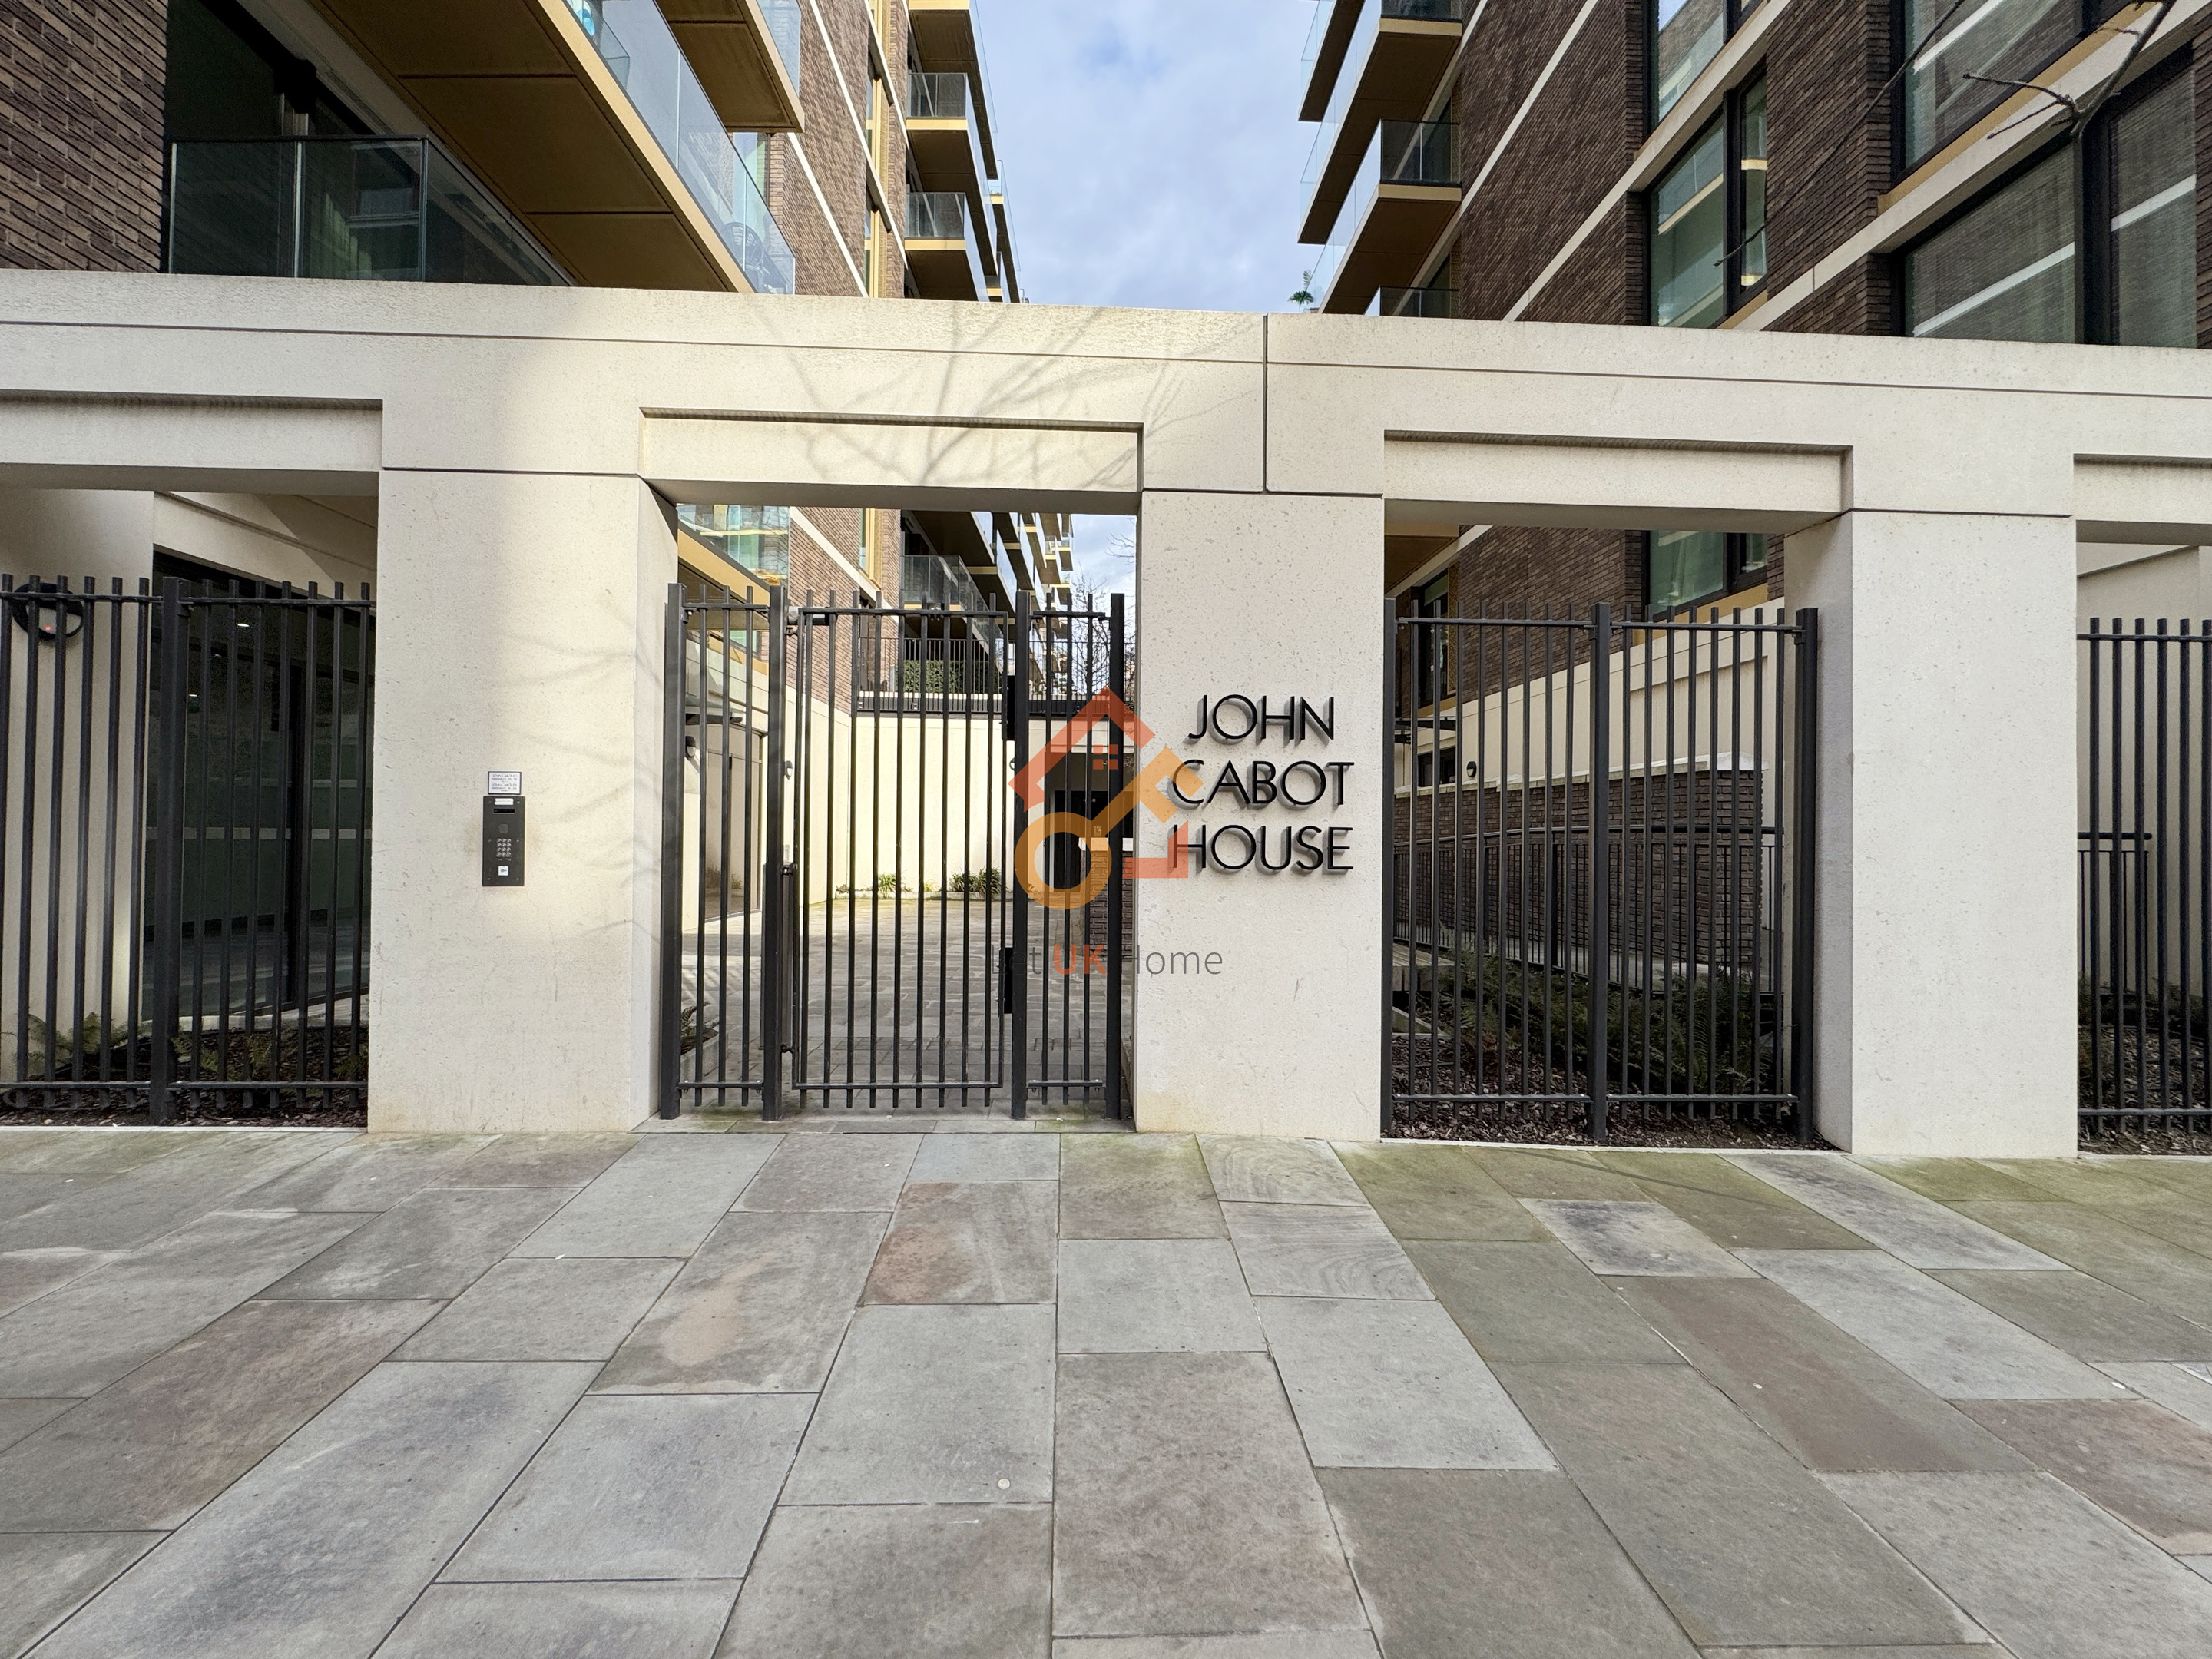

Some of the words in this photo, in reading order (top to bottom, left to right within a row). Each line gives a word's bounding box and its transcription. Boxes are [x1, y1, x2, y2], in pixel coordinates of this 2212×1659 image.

[1187, 694, 1335, 741] JOHN
[1172, 759, 1355, 806] CABOT
[1173, 824, 1354, 870] HOUSE
